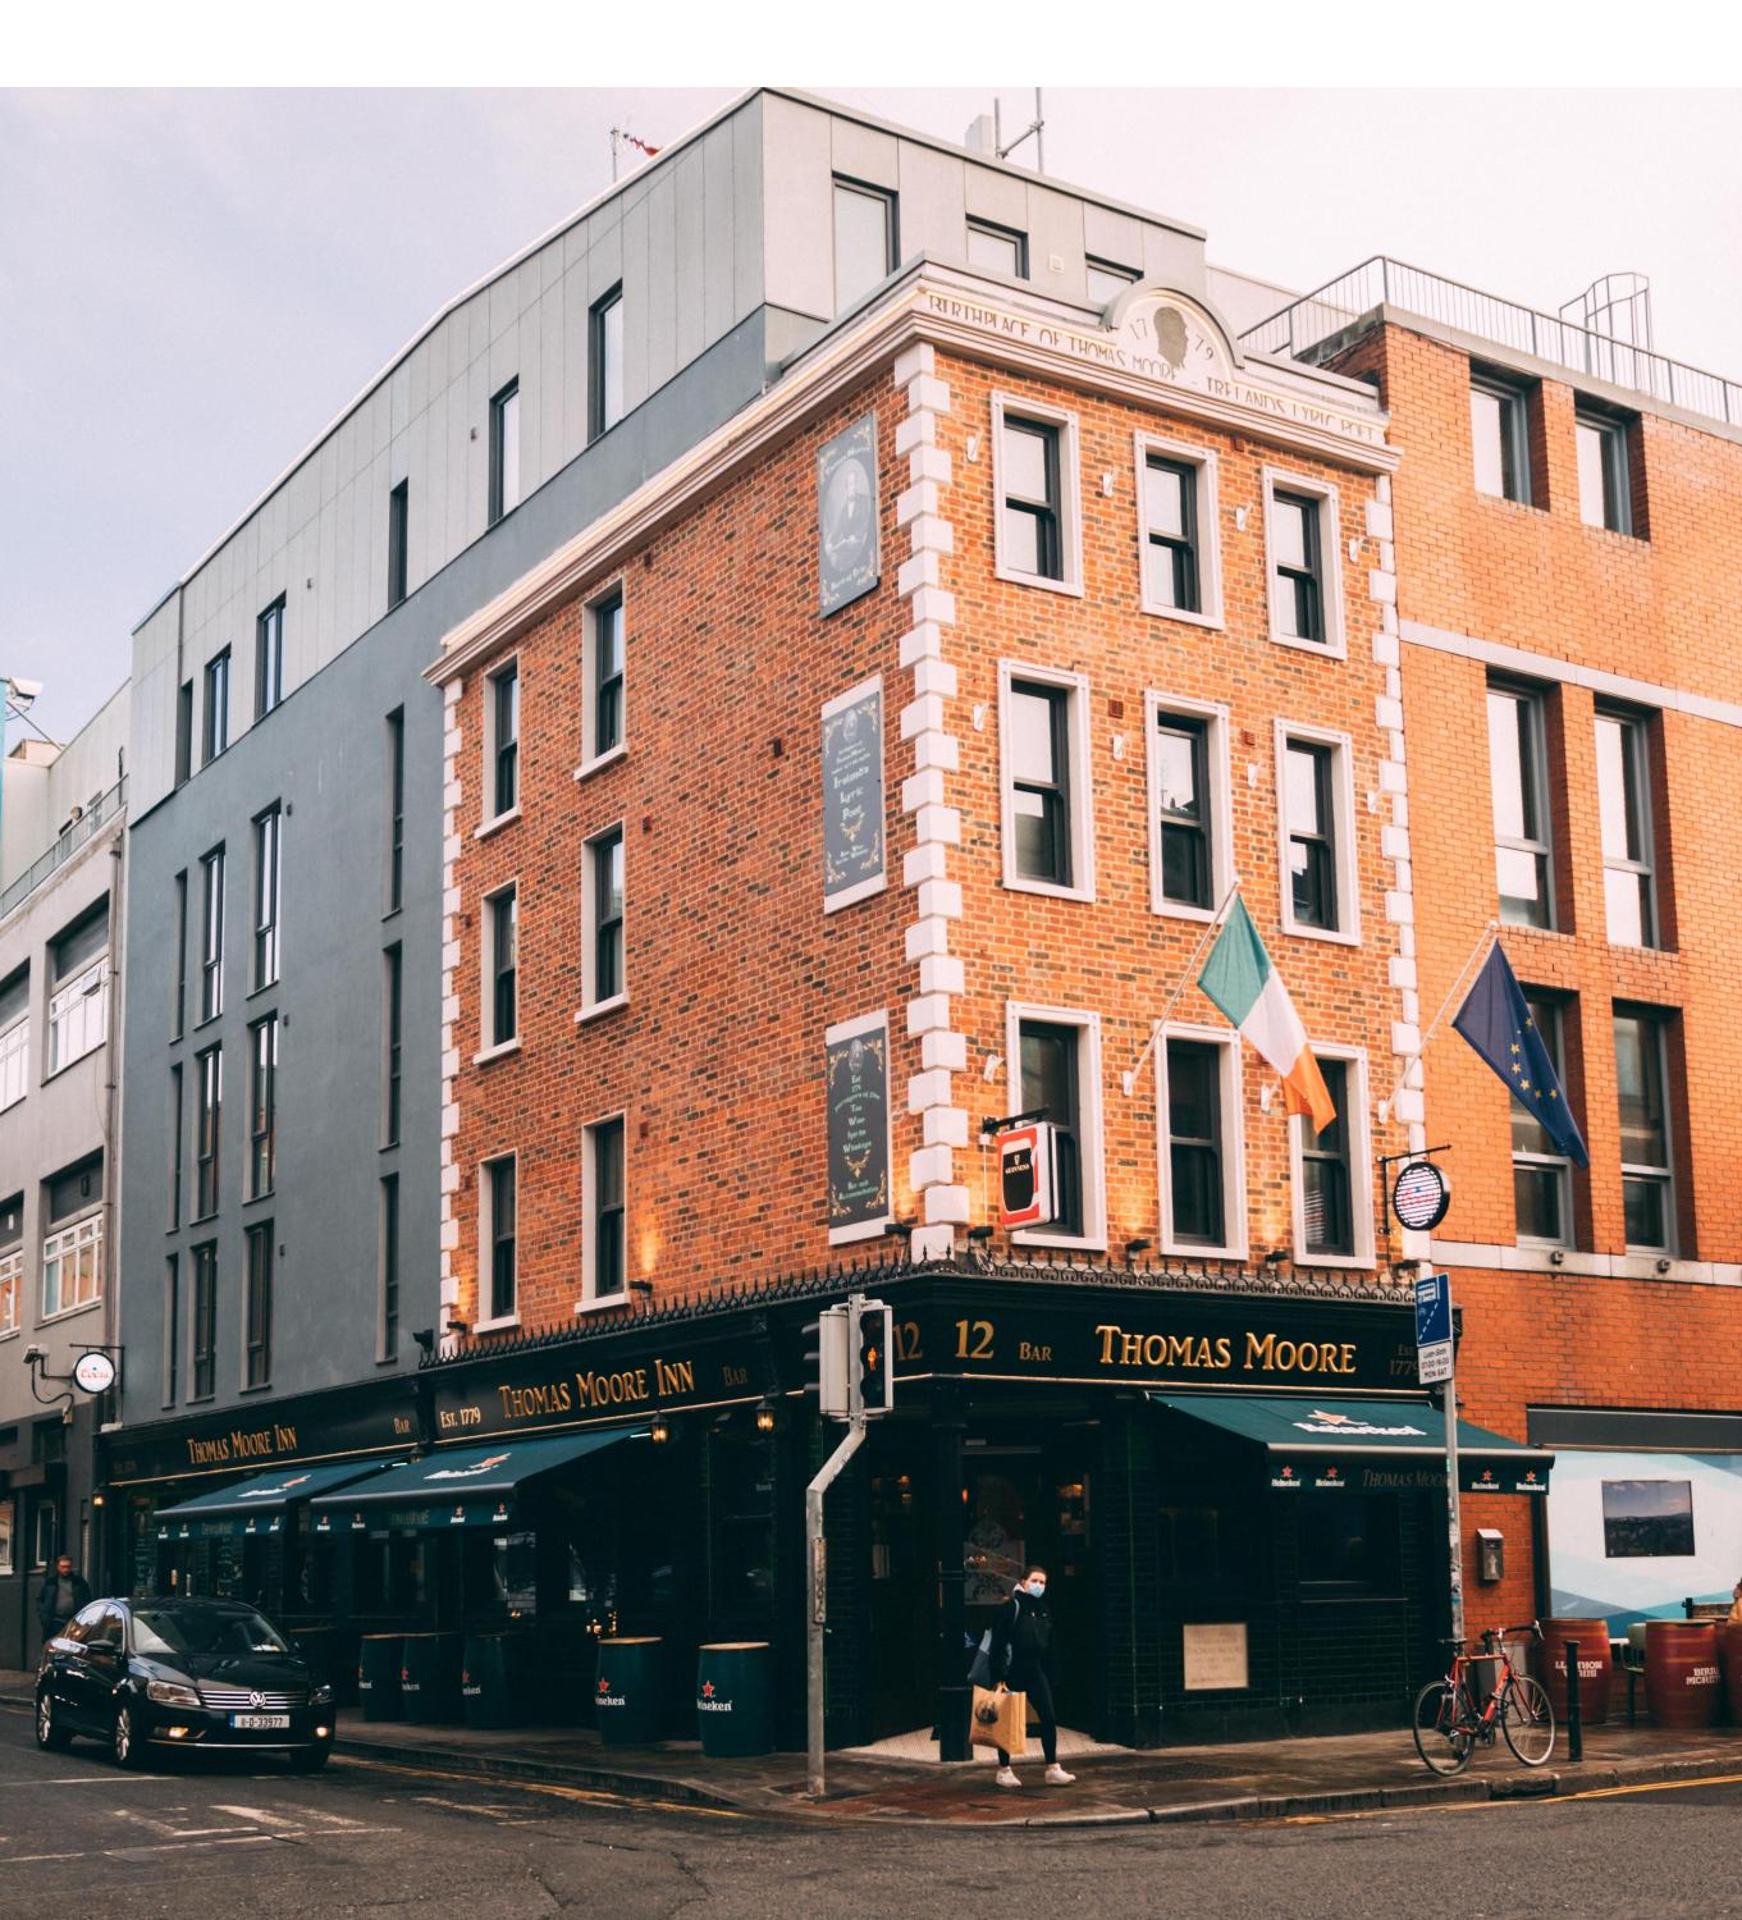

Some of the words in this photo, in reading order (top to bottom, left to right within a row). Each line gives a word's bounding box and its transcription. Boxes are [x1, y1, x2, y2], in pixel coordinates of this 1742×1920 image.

[929, 295, 1031, 338] BIRTHPLACE
[1039, 328, 1060, 347] OF
[1069, 337, 1126, 367] THOMAS
[893, 1321, 924, 1361] 12
[954, 1319, 995, 1360] 12
[1095, 1325, 1232, 1369] THOMAS
[1243, 1332, 1357, 1374] MOORE
[498, 1382, 572, 1420] THOMAS
[575, 1369, 650, 1409] MOORE
[654, 1358, 695, 1397] INN
[460, 1406, 482, 1425] 1779
[187, 1438, 229, 1465] THOMAS
[230, 1430, 273, 1458] MOORE
[274, 1424, 298, 1452] INN
